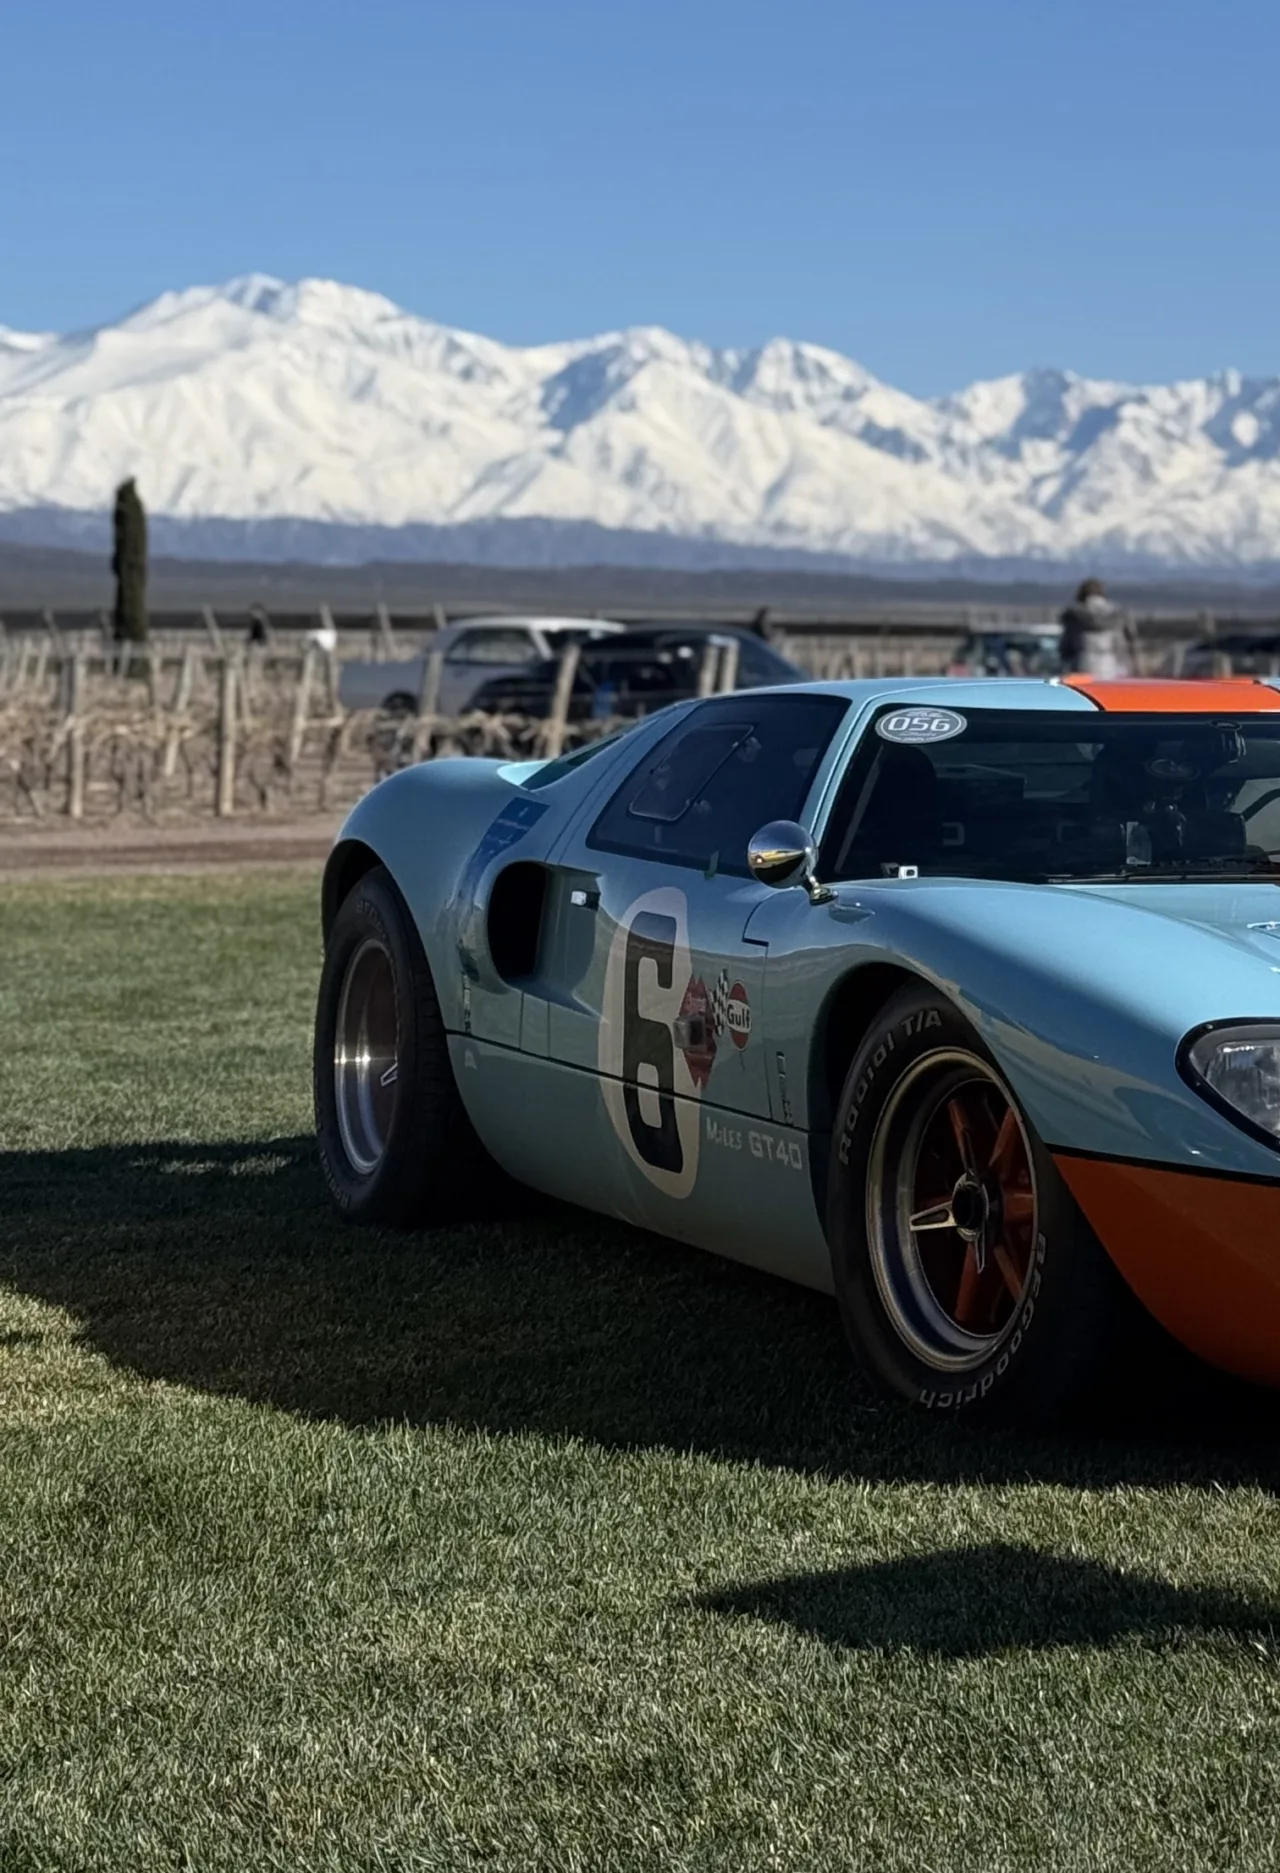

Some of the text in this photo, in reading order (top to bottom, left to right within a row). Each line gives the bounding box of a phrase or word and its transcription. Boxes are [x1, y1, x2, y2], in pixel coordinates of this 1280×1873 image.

[887, 716, 951, 732] 056
[727, 1003, 750, 1030] Gulf
[623, 911, 684, 1174] 6
[838, 1008, 943, 1166] Radial T/A
[748, 1130, 803, 1171] GT40
